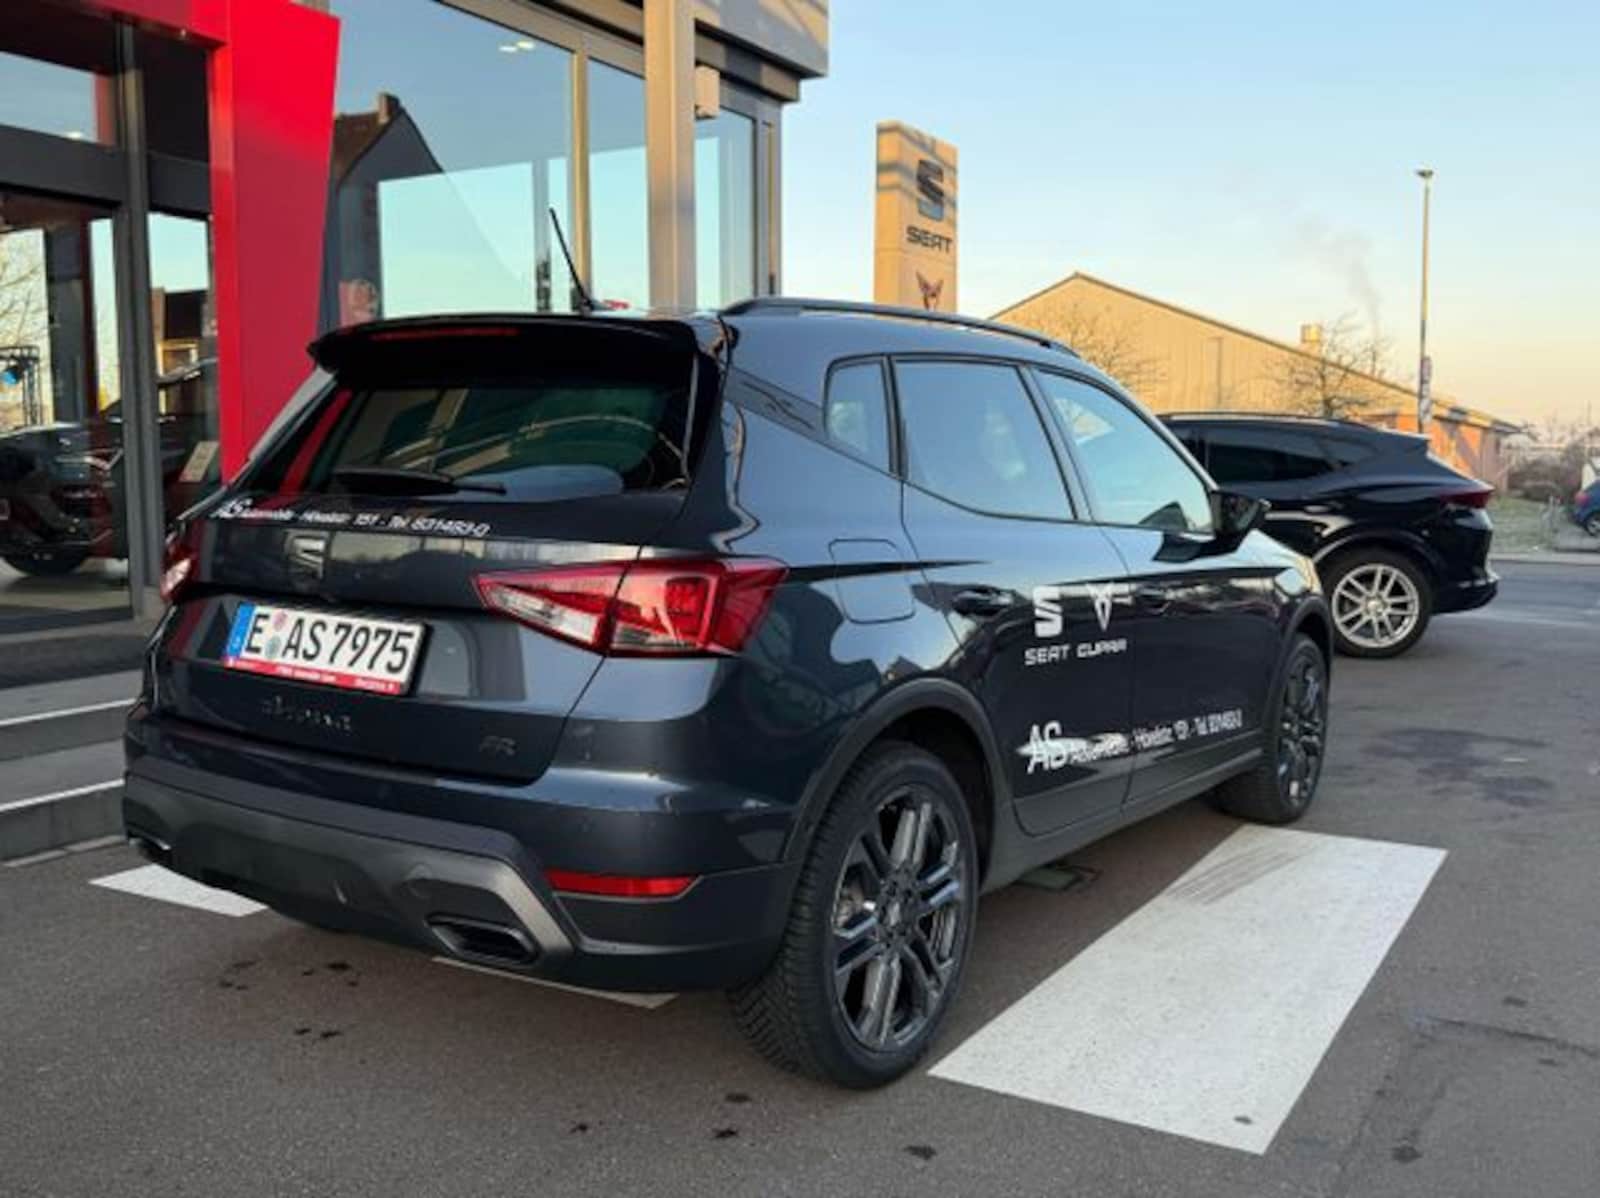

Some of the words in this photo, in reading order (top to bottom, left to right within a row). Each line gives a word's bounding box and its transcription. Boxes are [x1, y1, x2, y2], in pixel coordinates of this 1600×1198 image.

[906, 225, 953, 253] SEAT
[244, 613, 270, 655] E
[1023, 644, 1071, 666] SEAT
[1076, 638, 1128, 659] CUPRA
